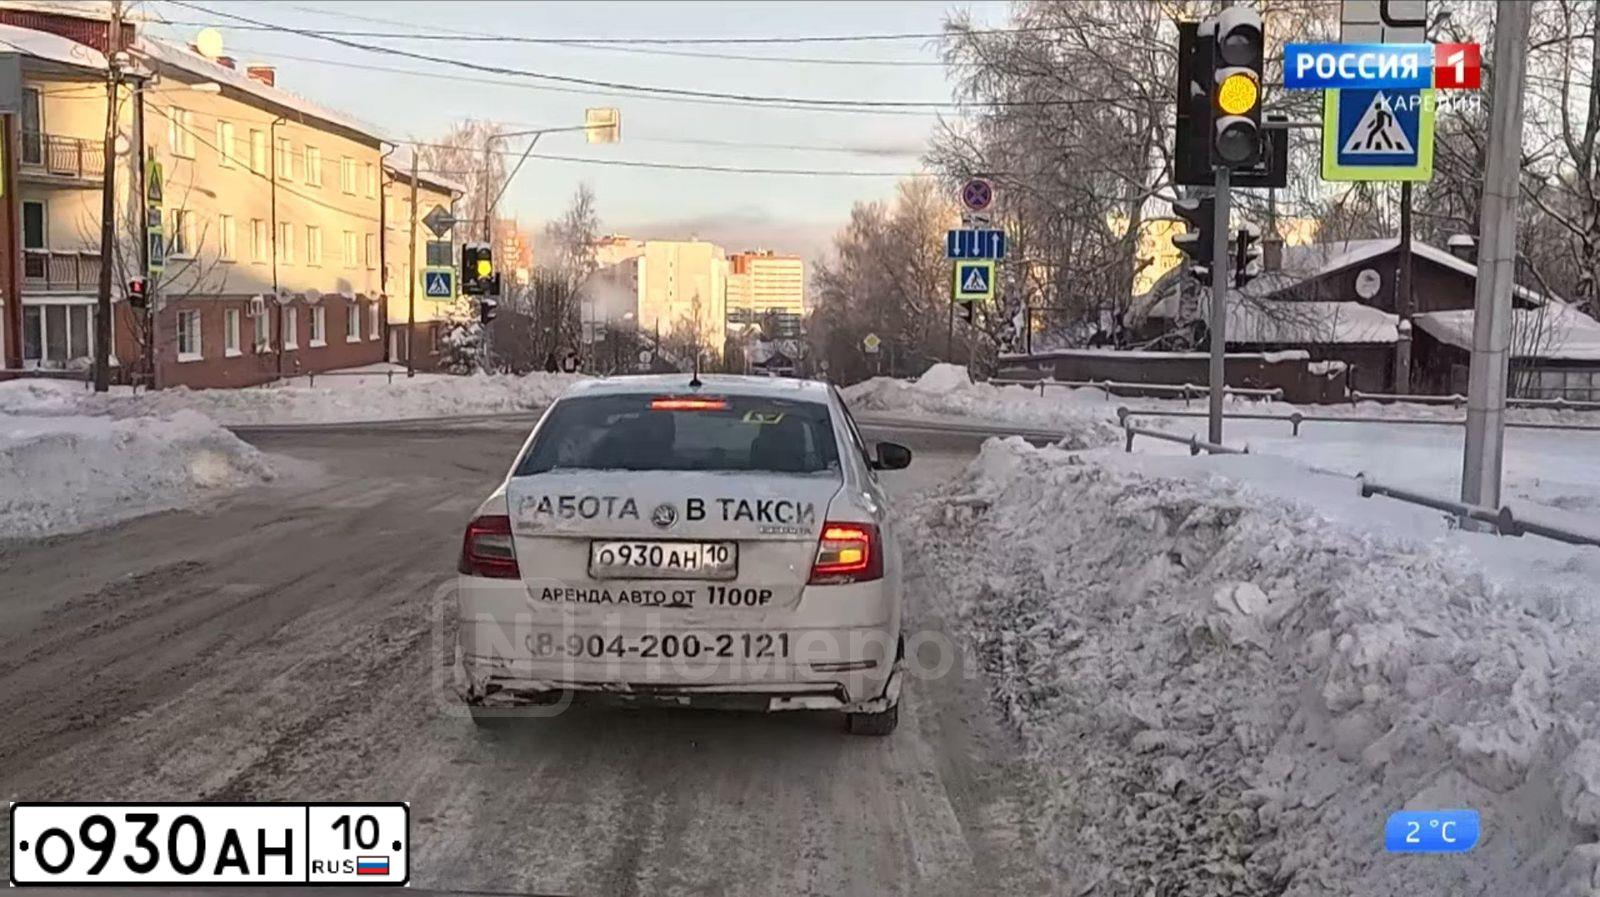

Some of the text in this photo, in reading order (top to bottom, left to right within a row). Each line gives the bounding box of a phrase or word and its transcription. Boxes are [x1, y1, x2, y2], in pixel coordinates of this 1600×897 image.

[518, 495, 815, 526] РАБОТА В ТАКСИ
[706, 546, 729, 563] 10
[541, 586, 612, 604] АРЕНДА
[617, 588, 667, 605] АВТО
[672, 590, 698, 605] ОТ
[537, 632, 791, 659] 8-904-200-2121
